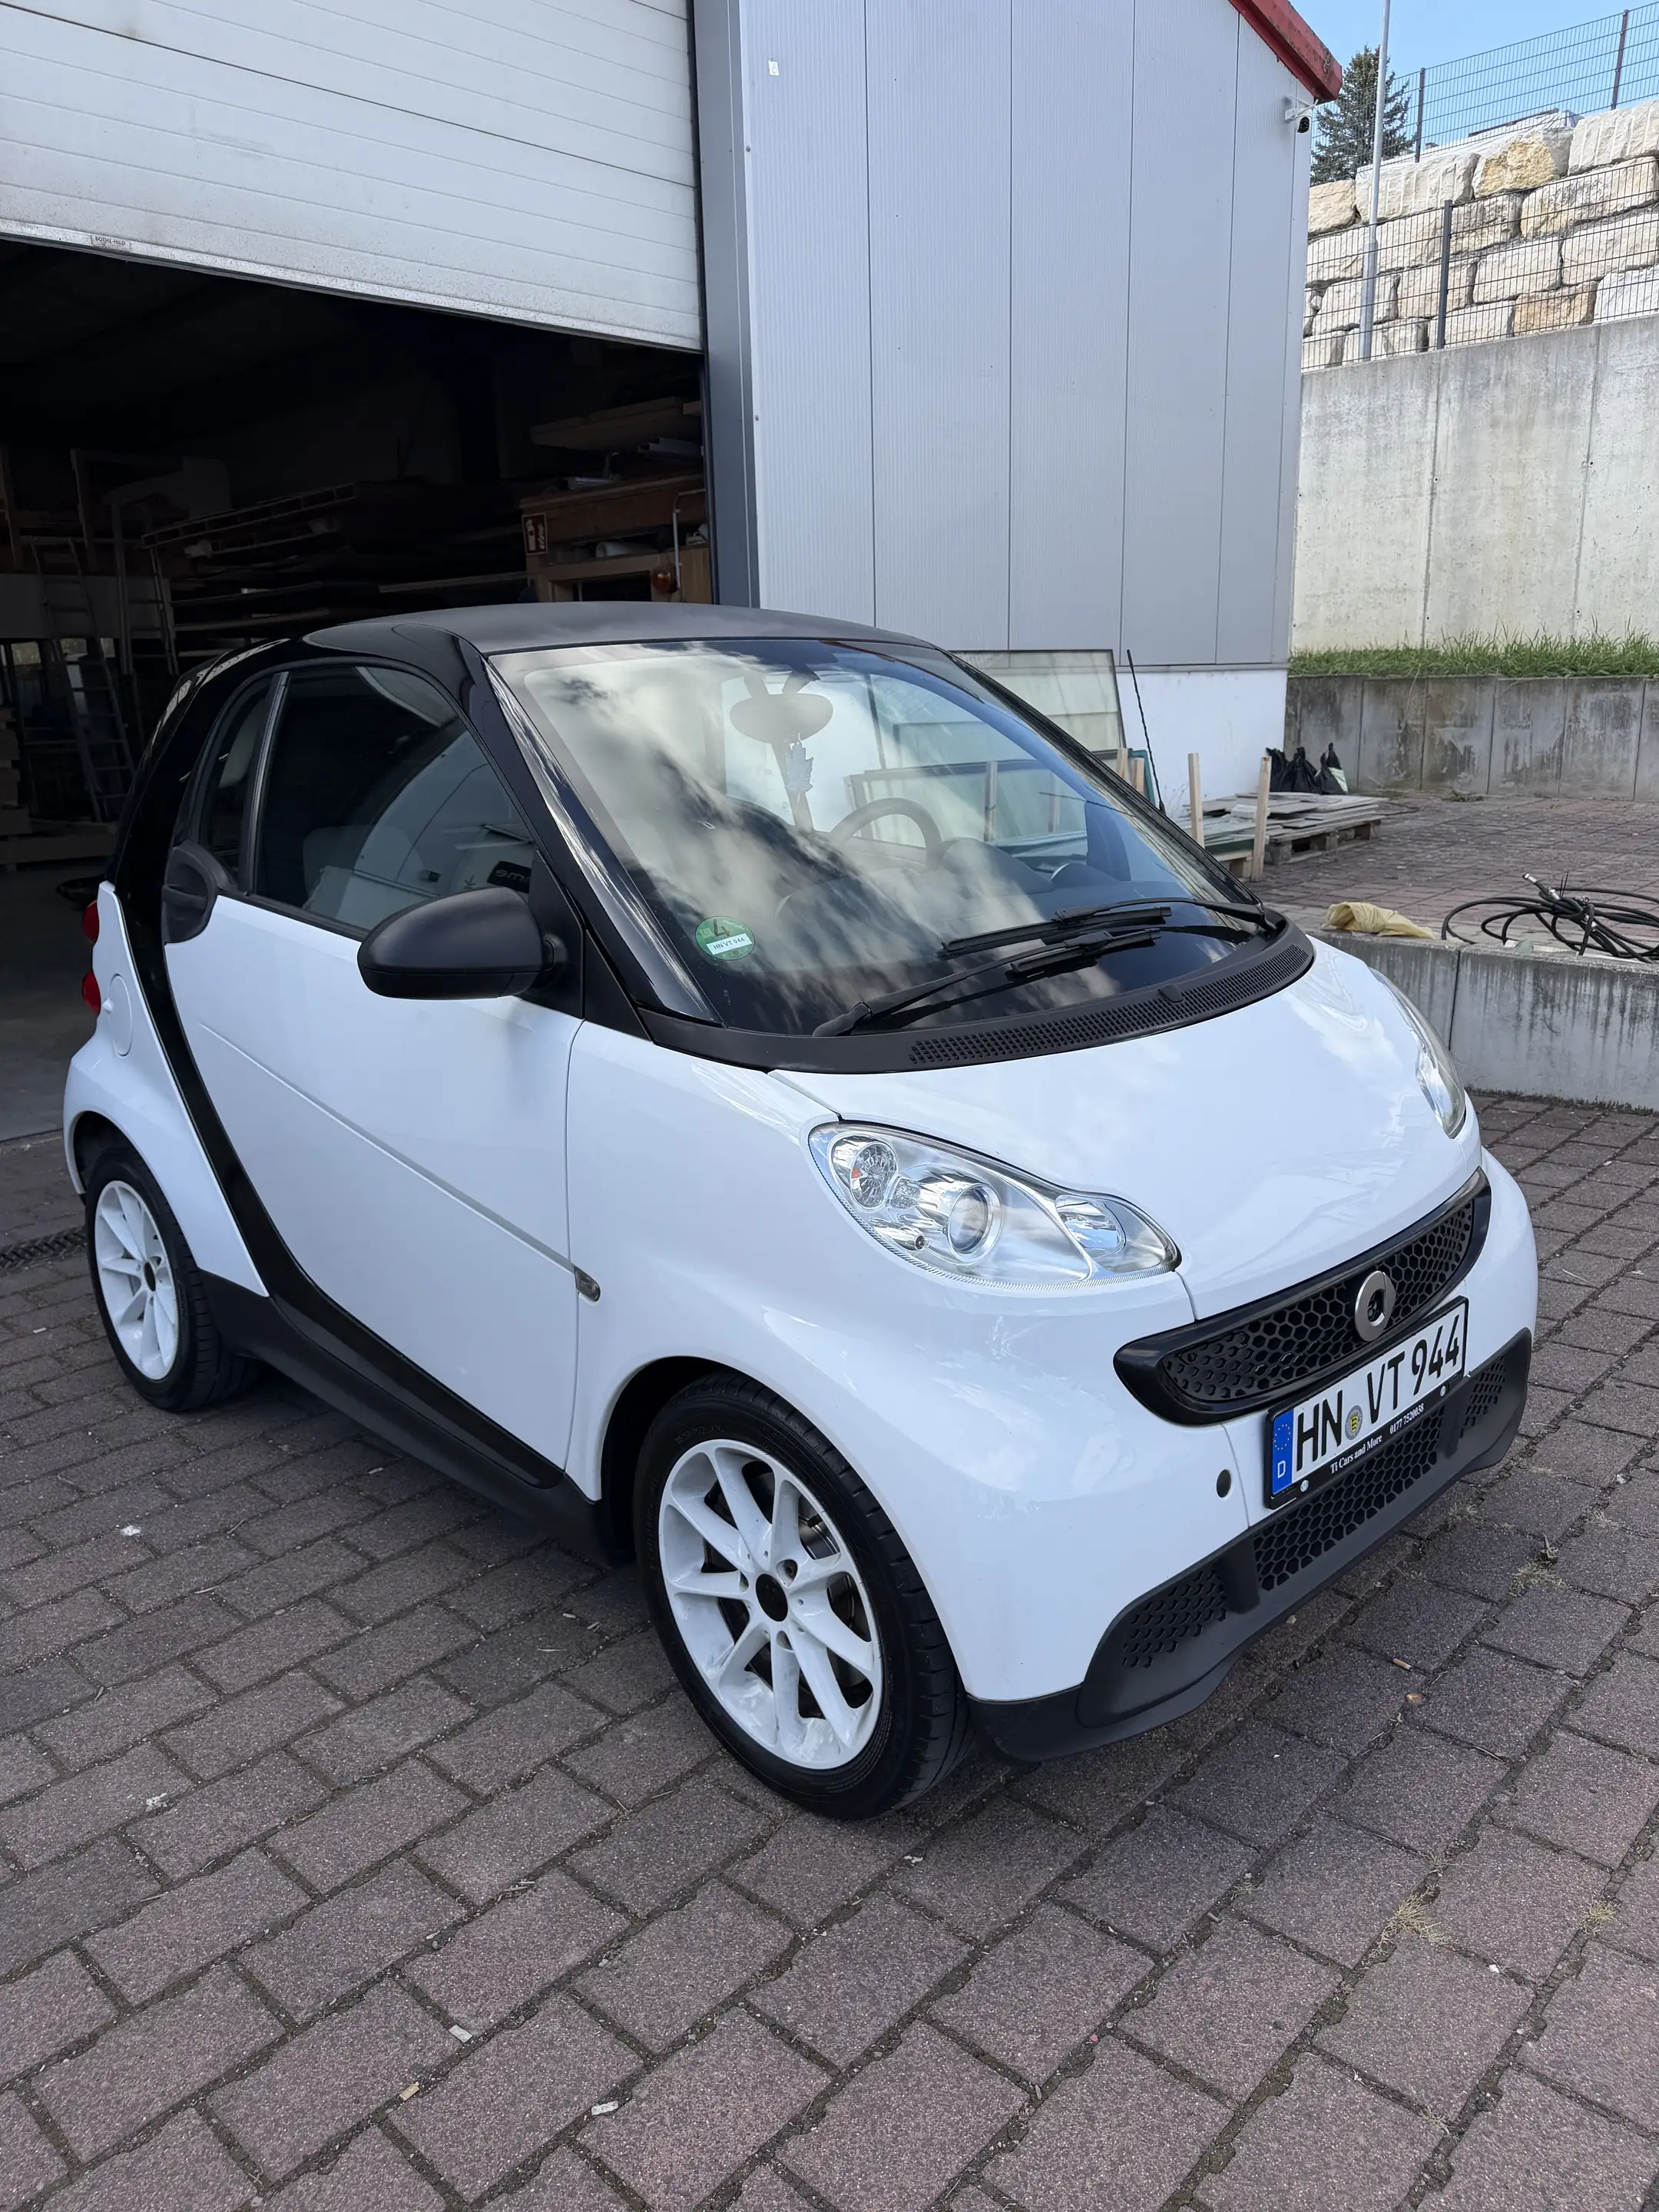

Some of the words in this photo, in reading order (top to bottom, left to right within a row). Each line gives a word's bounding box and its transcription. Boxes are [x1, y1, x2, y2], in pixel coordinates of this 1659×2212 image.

[714, 919, 730, 936] 4
[1296, 1389, 1343, 1472] HN
[1366, 1351, 1405, 1424] VT
[1411, 1313, 1460, 1396] 944
[1339, 1454, 1354, 1469] Cars
[1354, 1443, 1366, 1459] and
[1366, 1435, 1382, 1451] More
[1389, 1418, 1403, 1435] 0177
[1277, 1460, 1286, 1479] D
